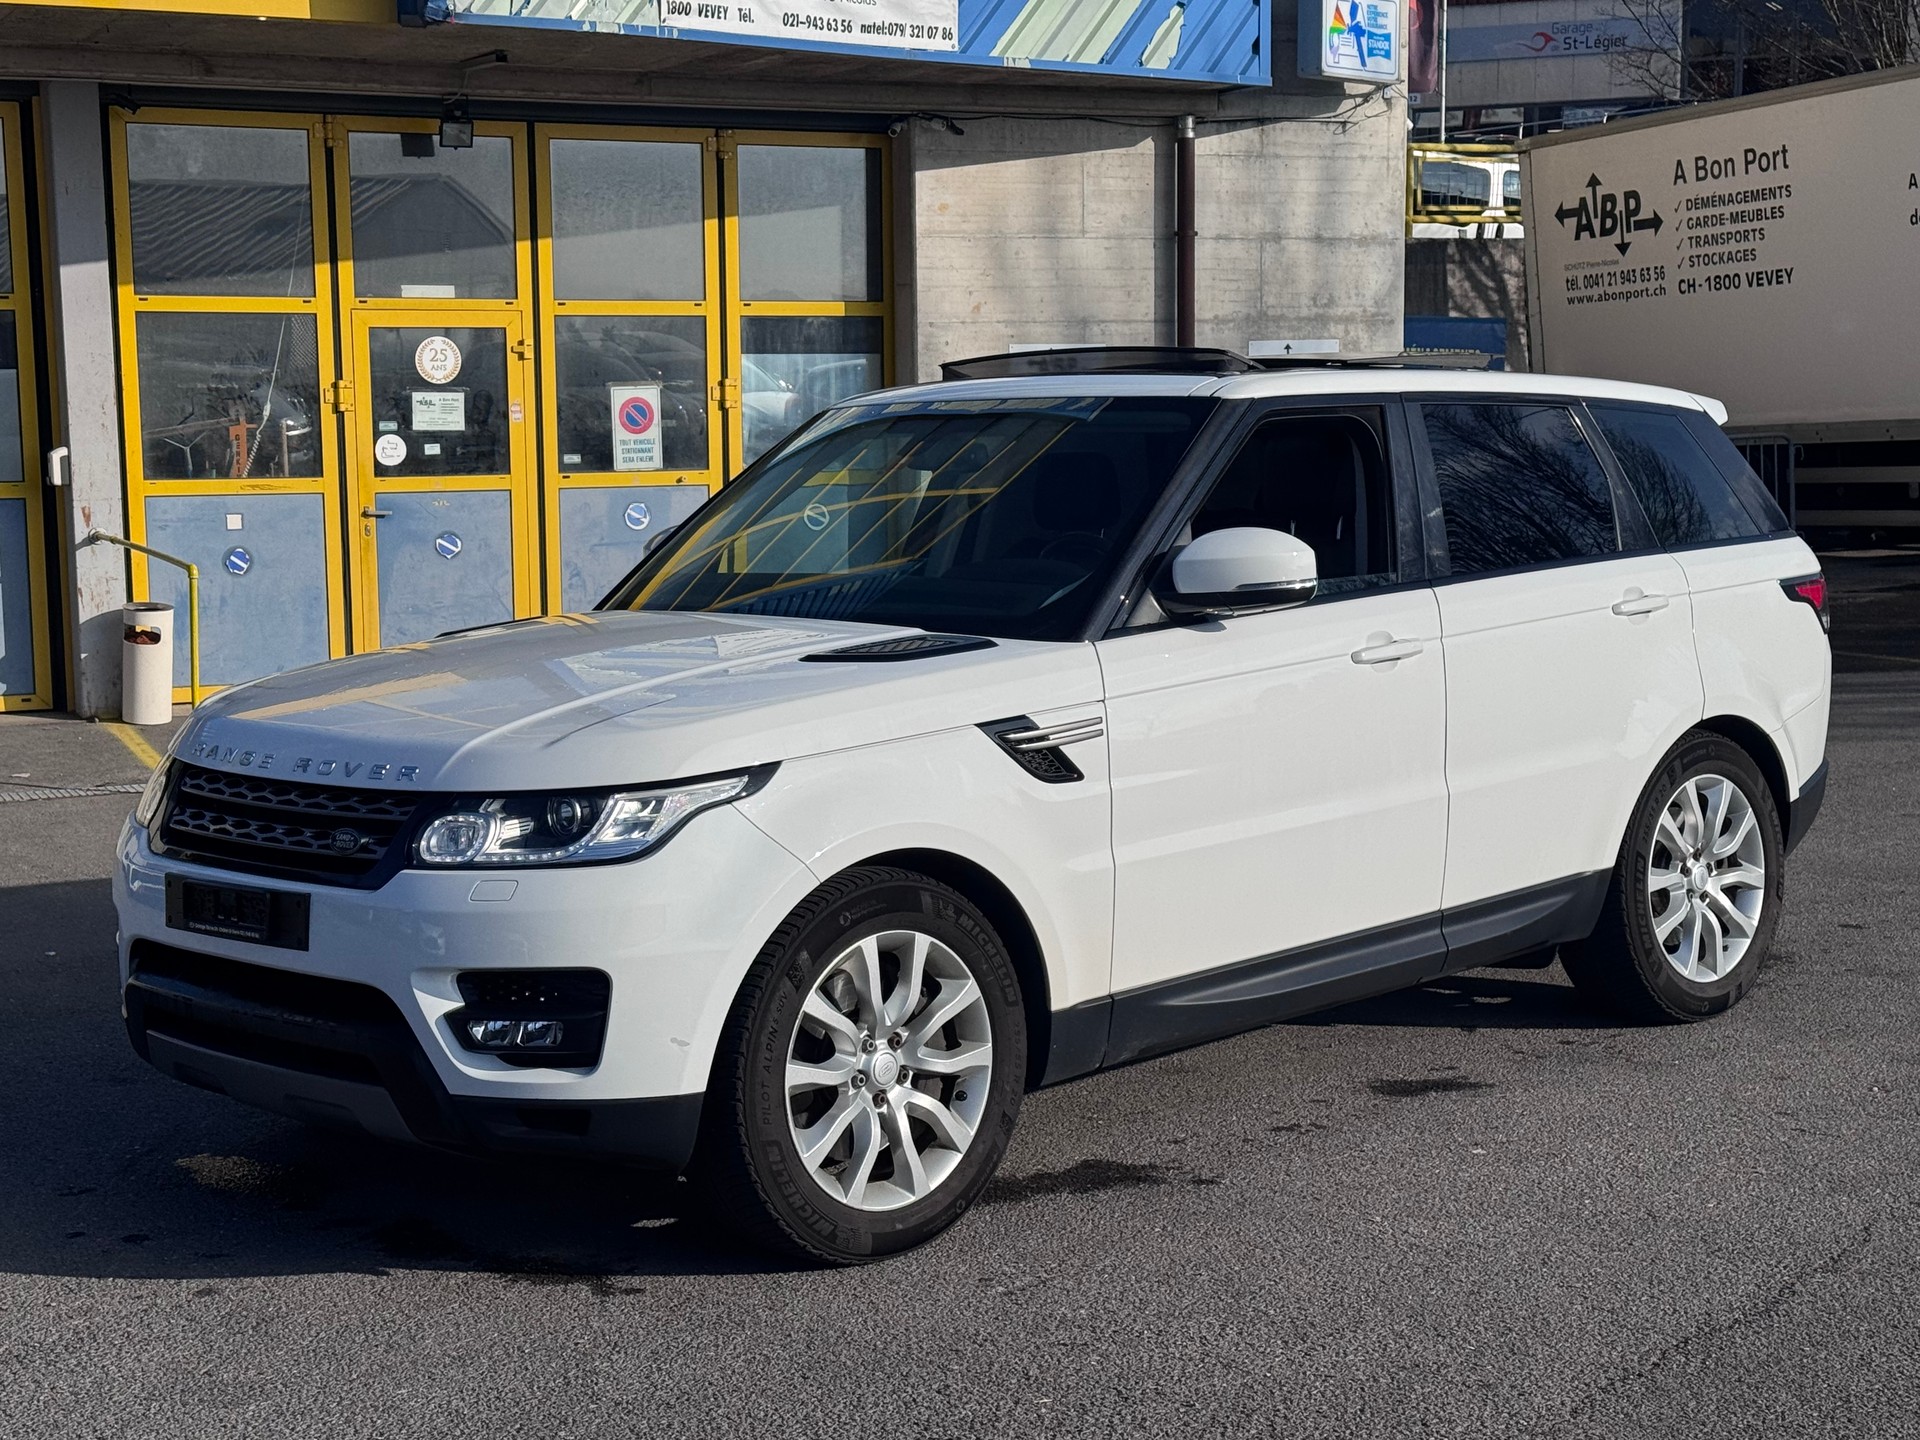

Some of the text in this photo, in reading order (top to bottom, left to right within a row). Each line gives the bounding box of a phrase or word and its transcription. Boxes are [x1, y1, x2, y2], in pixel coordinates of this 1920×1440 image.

[666, 0, 692, 17] 1800
[697, 3, 729, 21] VEVEY
[737, 7, 755, 24] Tél.
[826, 19, 839, 32] 63
[840, 20, 853, 34] 56
[909, 24, 925, 39] 321
[927, 25, 939, 40] 07
[942, 27, 954, 42] 86
[1551, 22, 1594, 36] Garage
[1368, 39, 1390, 50] STANDOX
[1563, 34, 1628, 51] St-Légier
[1673, 144, 1789, 186] A Bon Port
[1908, 172, 1919, 190] A
[1685, 184, 1792, 212] DÉMÉNAGEMENTS
[1573, 189, 1642, 241] ABP
[1687, 205, 1785, 231] GARDE-MEUBLES
[1910, 208, 1920, 226] d
[1687, 227, 1766, 250] TRANSPORTS
[1688, 248, 1757, 268] STOCKAGES
[1565, 265, 1666, 292] tél. 0041 21 943 63 56
[1745, 266, 1795, 289] VEVEY
[1566, 283, 1667, 306] www.abonport.ch
[429, 348, 448, 363] 25
[621, 447, 654, 455] STATIONNANT
[633, 438, 655, 446] VEHICULE
[191, 742, 420, 782] RANGE ROVER
[1635, 855, 1653, 949] MICHELIN
[957, 913, 1017, 1003] MICHELIN
[763, 1026, 779, 1074] ALPIN
[761, 1082, 772, 1126] PILOT
[766, 1145, 836, 1236] MICHELIN
